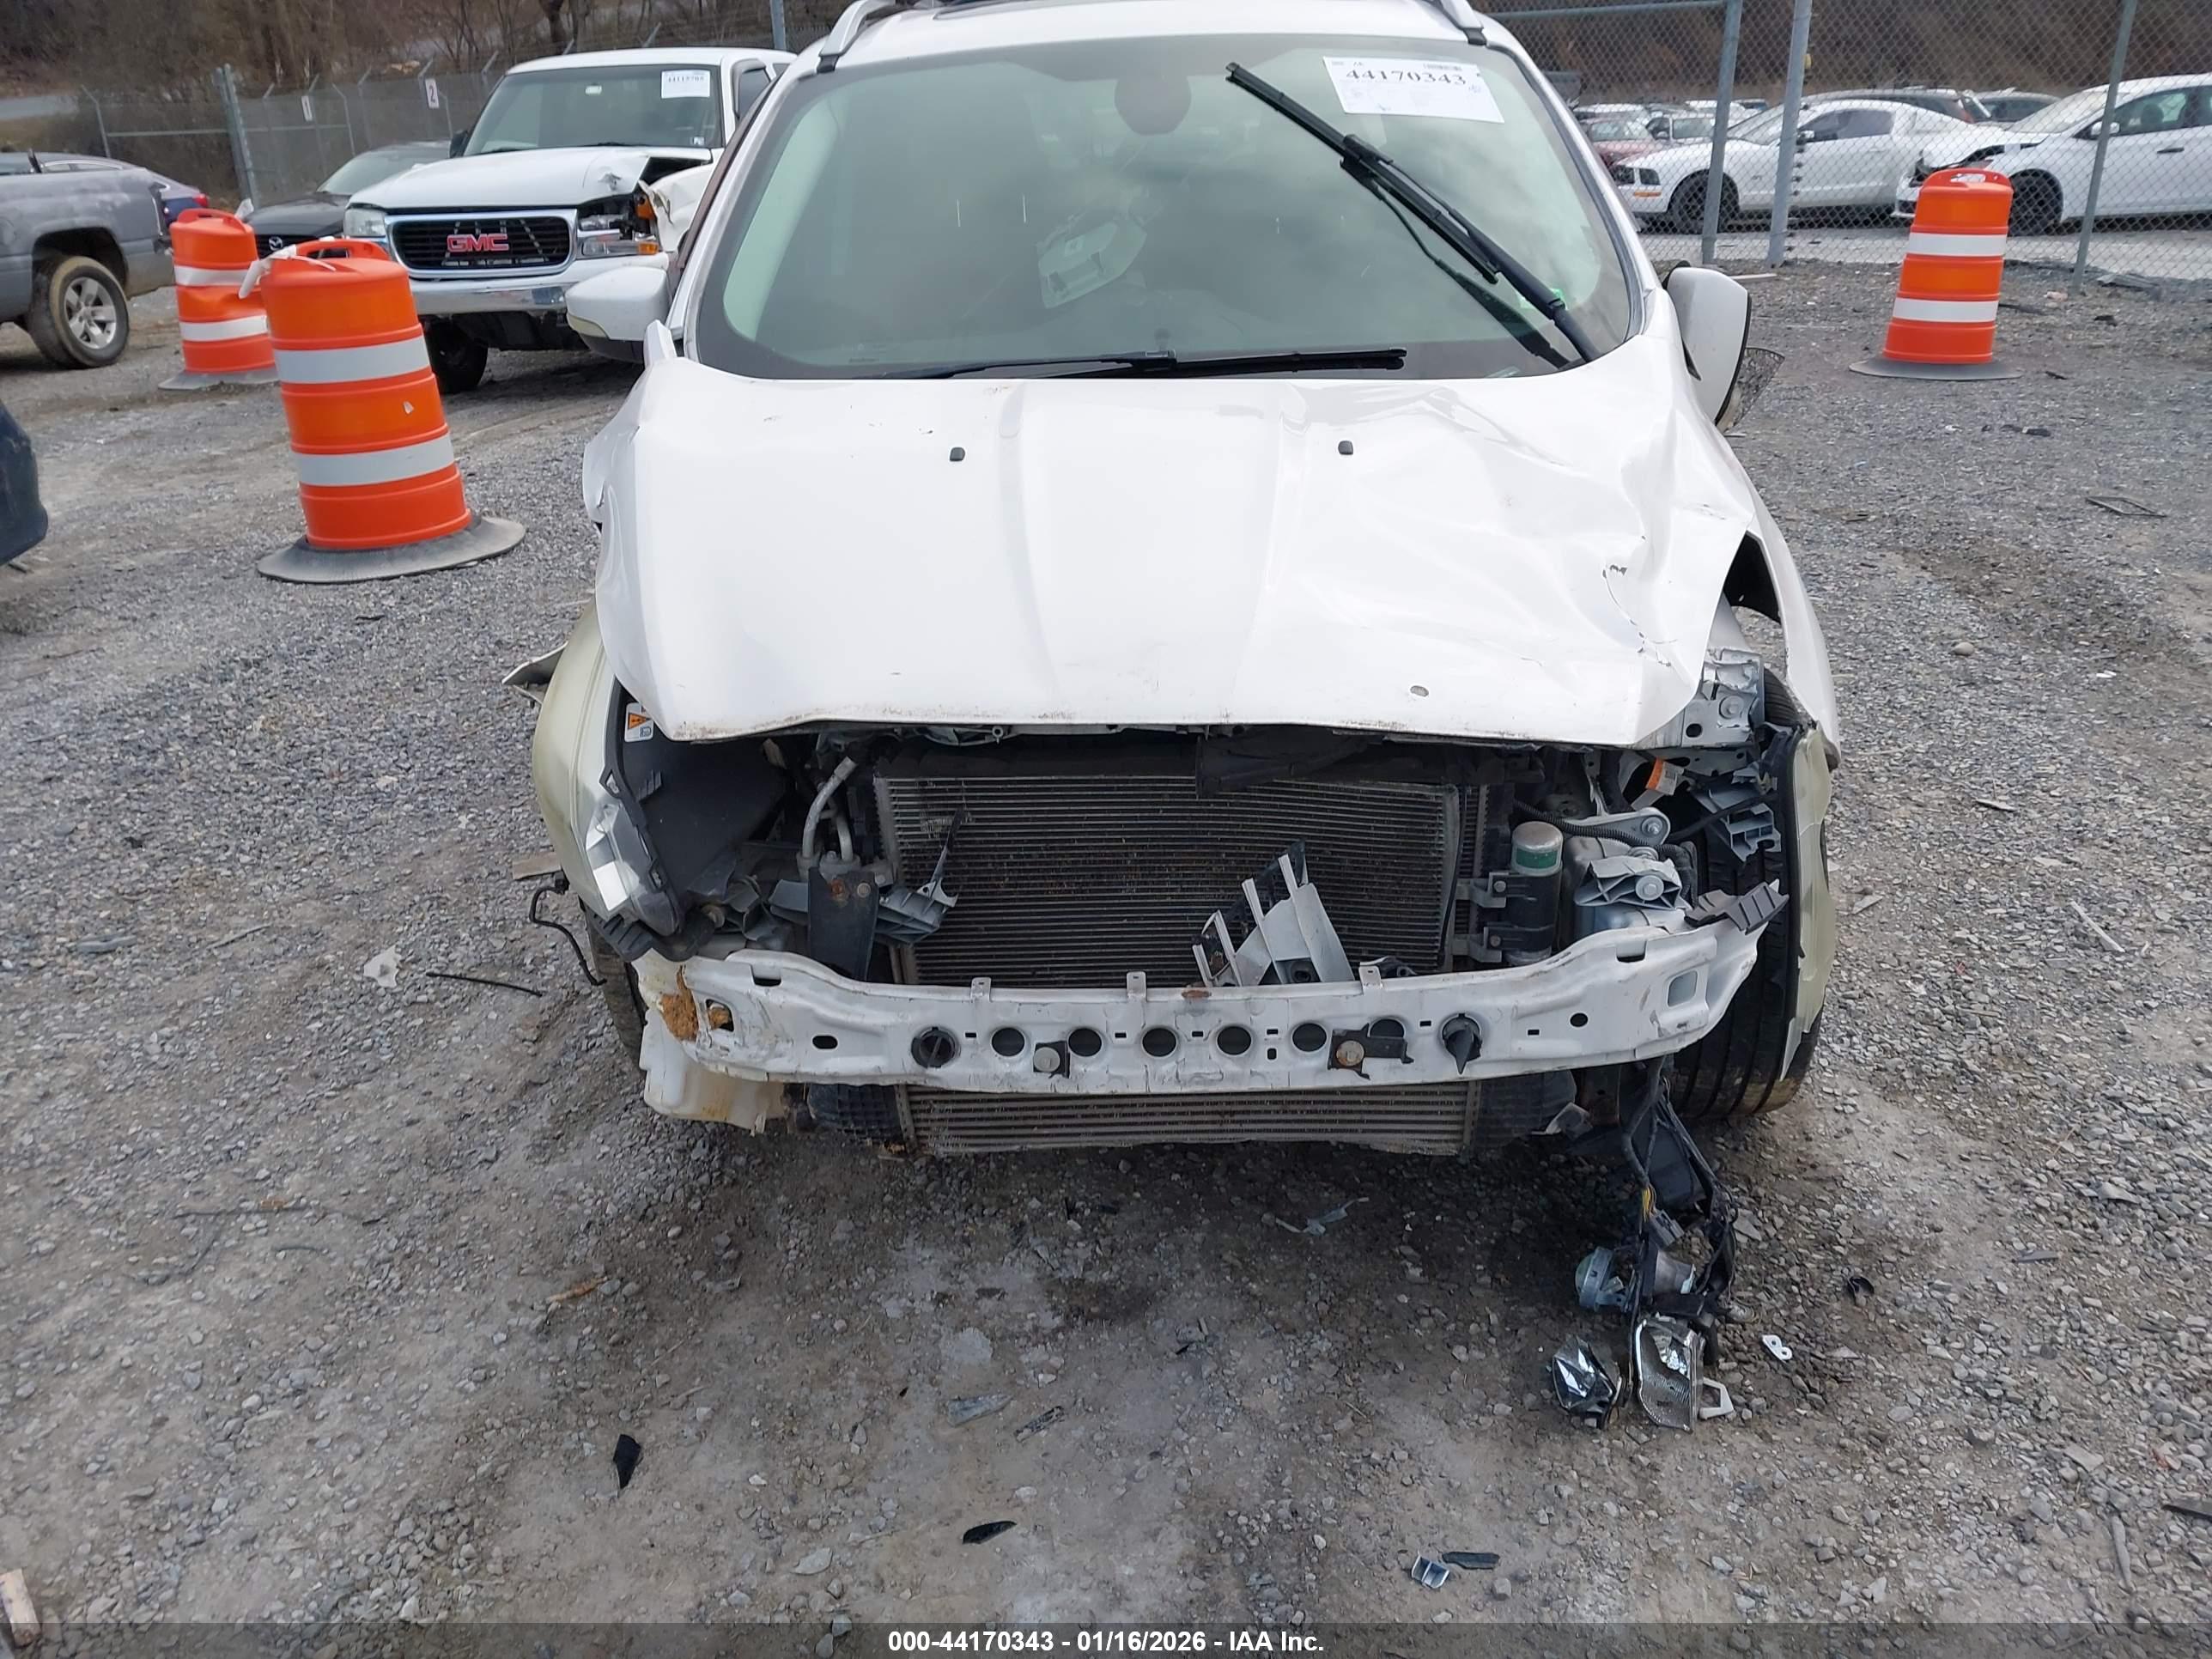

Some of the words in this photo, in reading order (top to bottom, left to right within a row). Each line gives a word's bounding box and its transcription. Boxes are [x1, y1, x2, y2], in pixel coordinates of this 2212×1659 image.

[1346, 70, 1467, 85] 44170343
[428, 85, 436, 103] 2
[447, 233, 509, 252] GMC
